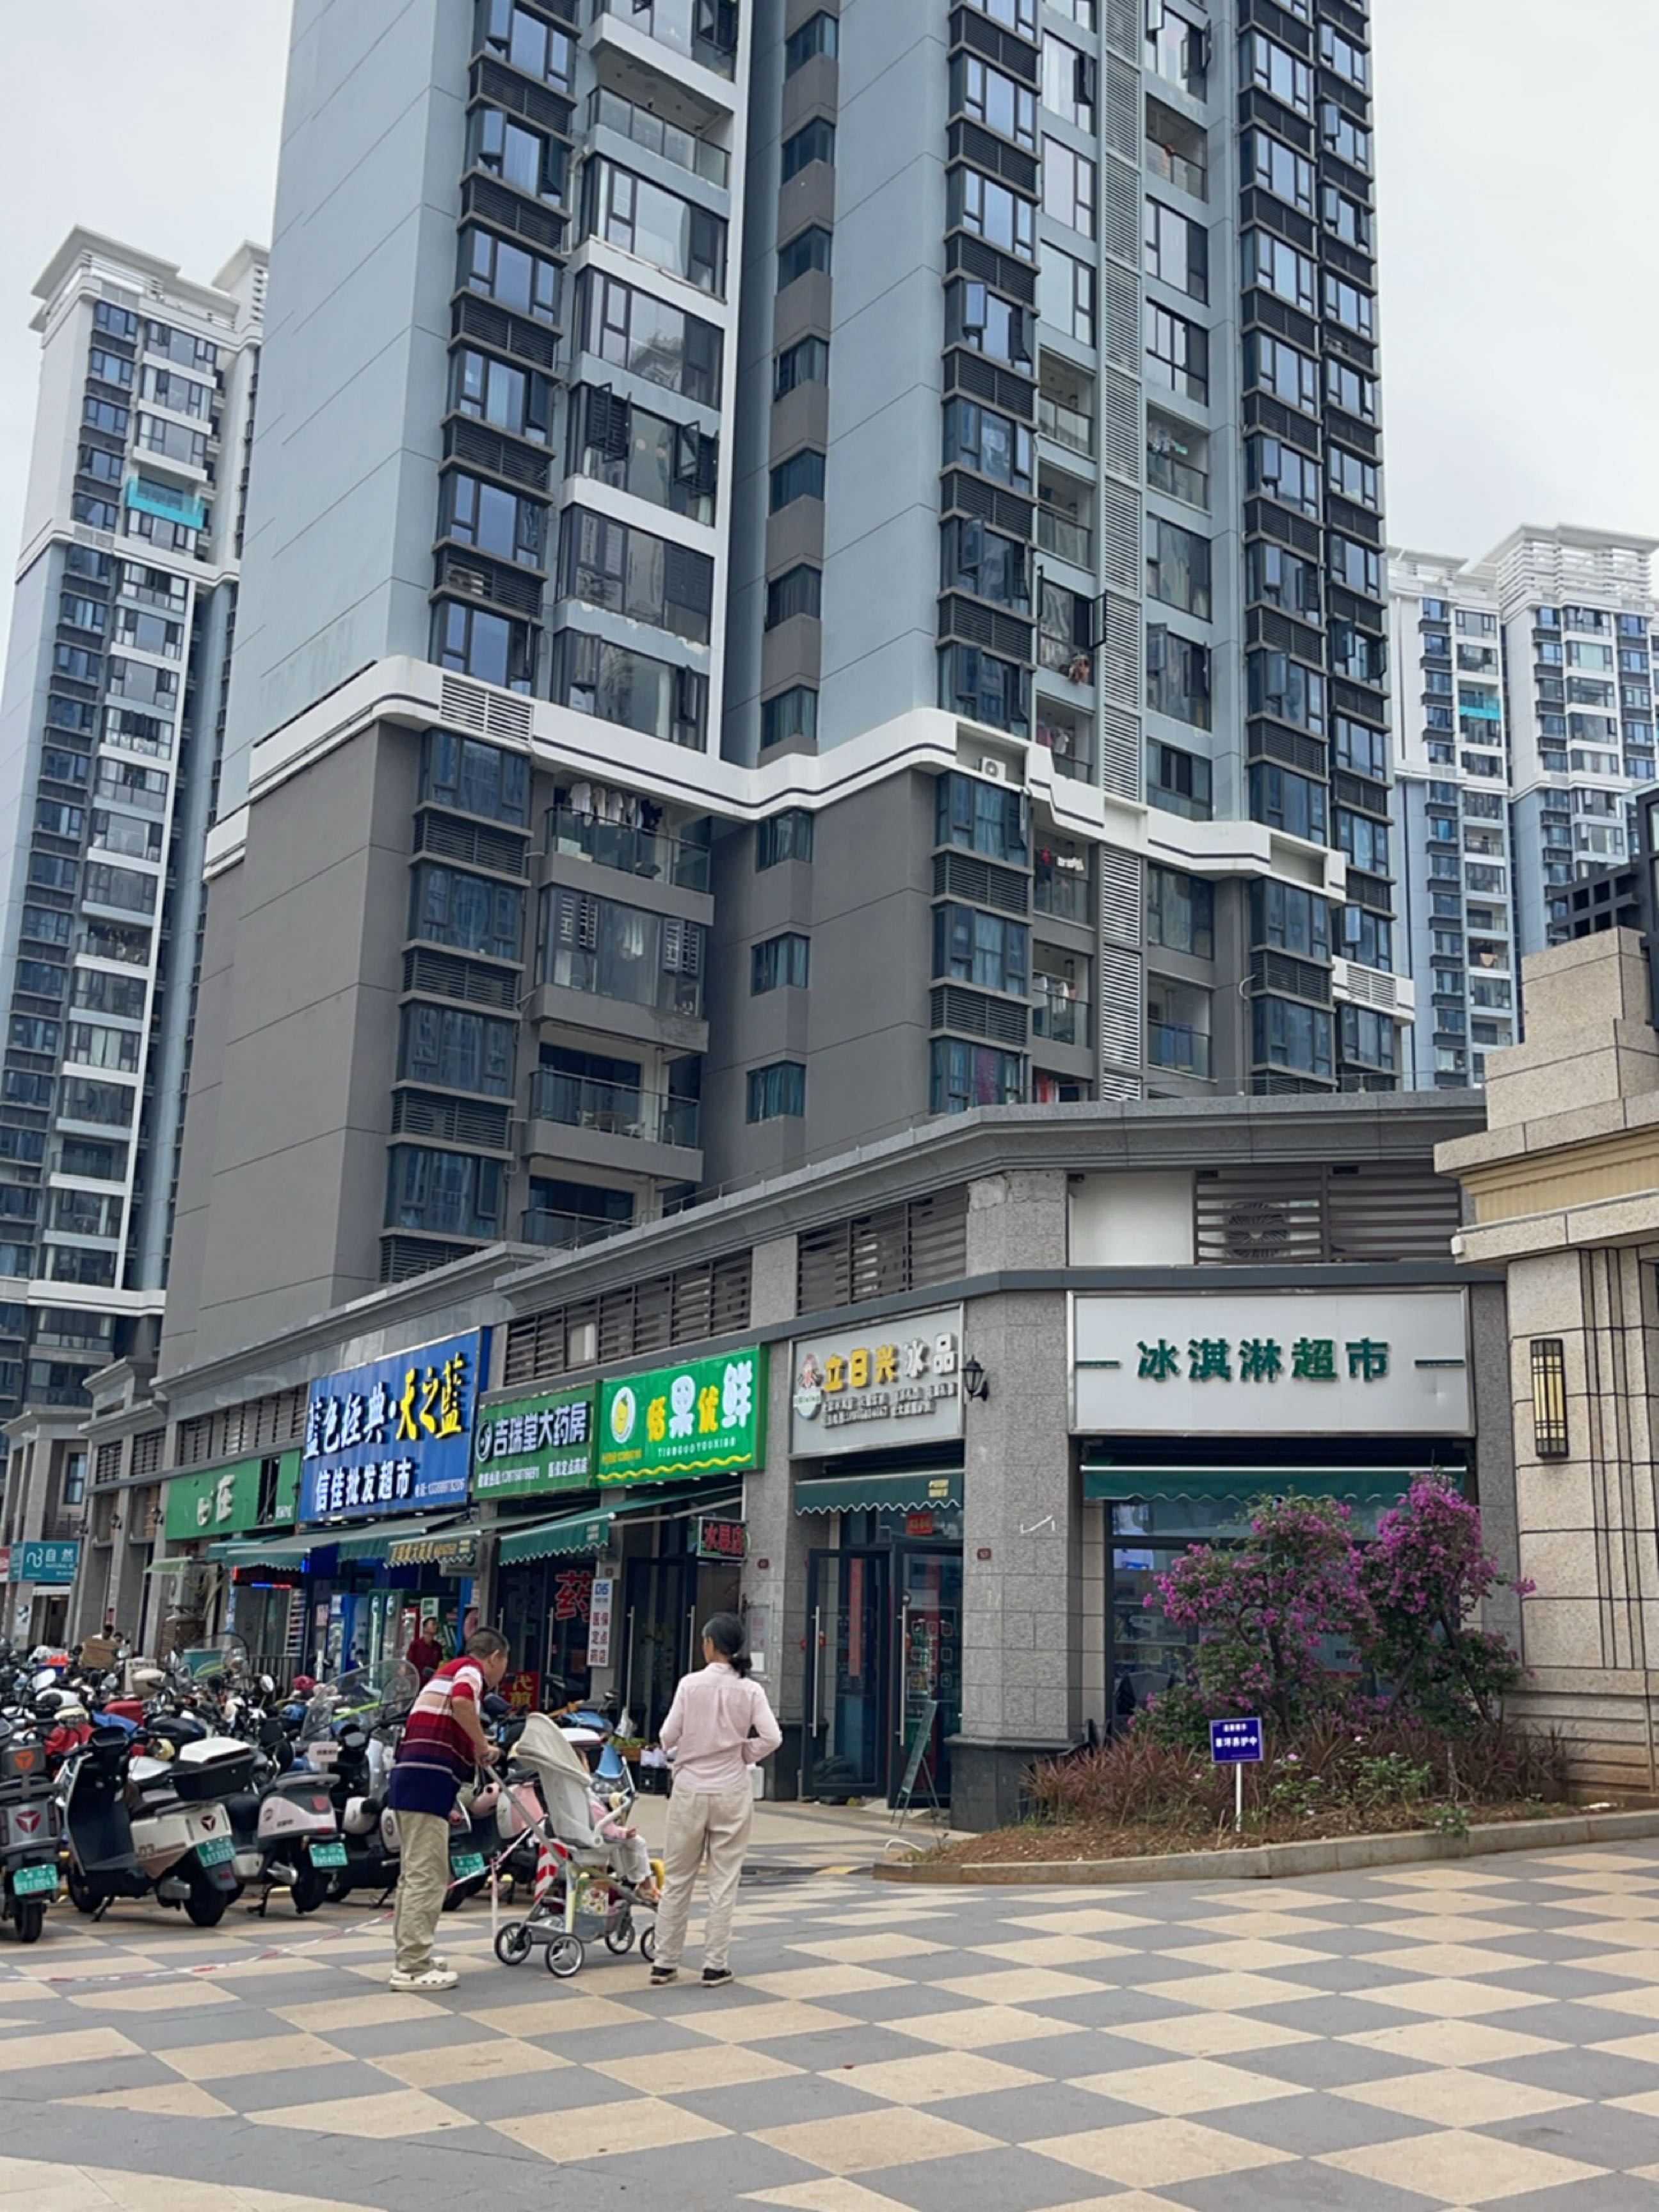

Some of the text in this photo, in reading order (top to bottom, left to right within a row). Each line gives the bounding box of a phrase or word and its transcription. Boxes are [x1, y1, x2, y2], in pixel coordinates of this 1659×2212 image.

[1137, 1337, 1390, 1382] 冰淇淋超市
[493, 1401, 587, 1457] 吉瑞堂大药房
[316, 1457, 412, 1512] 信佳批发超市
